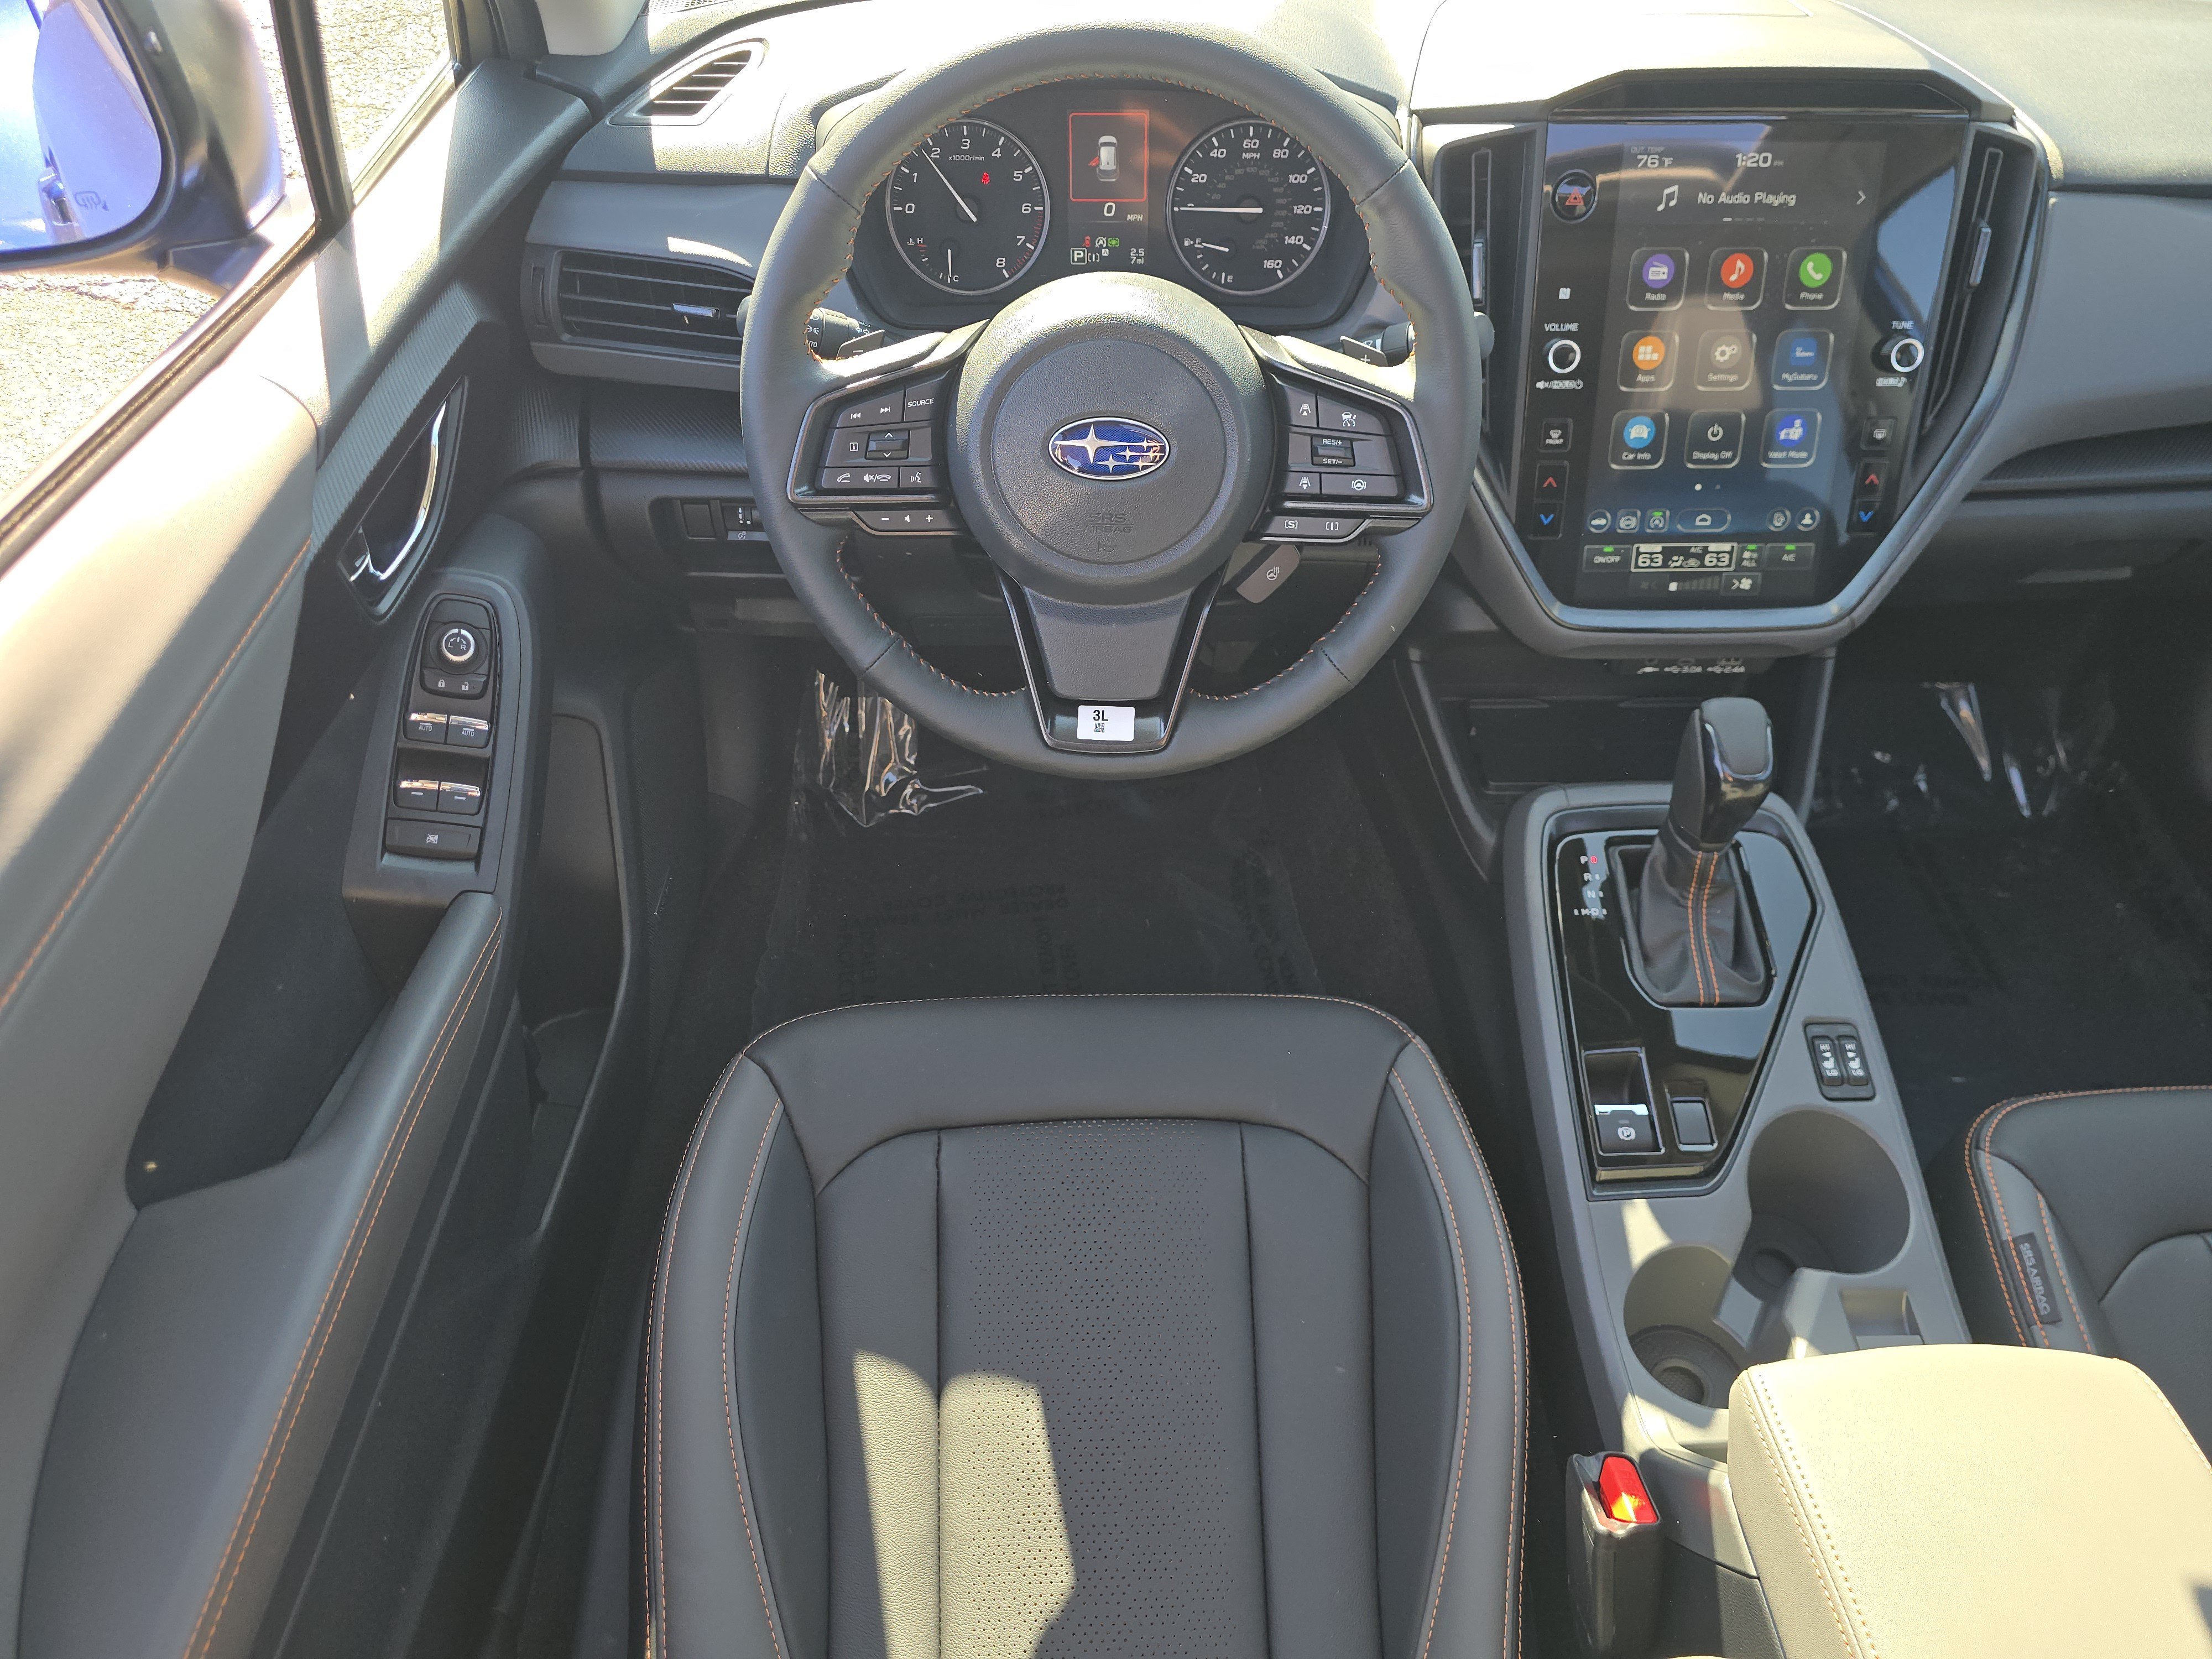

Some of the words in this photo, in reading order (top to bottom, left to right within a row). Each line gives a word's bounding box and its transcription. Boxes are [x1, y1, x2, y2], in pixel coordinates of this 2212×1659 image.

[961, 139, 970, 149] 3
[1243, 139, 1259, 148] 60
[931, 148, 940, 158] 2
[992, 148, 1001, 158] 4
[1210, 149, 1227, 158] 40
[1273, 149, 1289, 158] 80
[1637, 155, 1660, 168] 76
[1735, 152, 1772, 168] 1:20
[912, 173, 917, 182] 1
[1014, 171, 1022, 181] 5
[1191, 174, 1207, 183] 20
[1288, 174, 1308, 183] 100
[1698, 192, 1714, 204] No
[1718, 192, 1750, 204] Audio
[1754, 192, 1797, 207] Playing
[905, 204, 915, 213] 0
[1021, 204, 1031, 213] 6
[1104, 202, 1116, 217] 0
[1293, 205, 1312, 214] 120
[1016, 236, 1025, 246] 7
[1285, 236, 1303, 244] 140
[1074, 251, 1084, 262] P
[996, 258, 1005, 268] 8
[1264, 260, 1282, 269] 160
[1544, 323, 1579, 332] VOLUME
[907, 398, 935, 407] SOURCE
[1638, 554, 1663, 567] 63
[1704, 553, 1730, 566] 63
[1093, 709, 1109, 722] 3L
[1580, 855, 1588, 864] P
[1583, 873, 1592, 881] R
